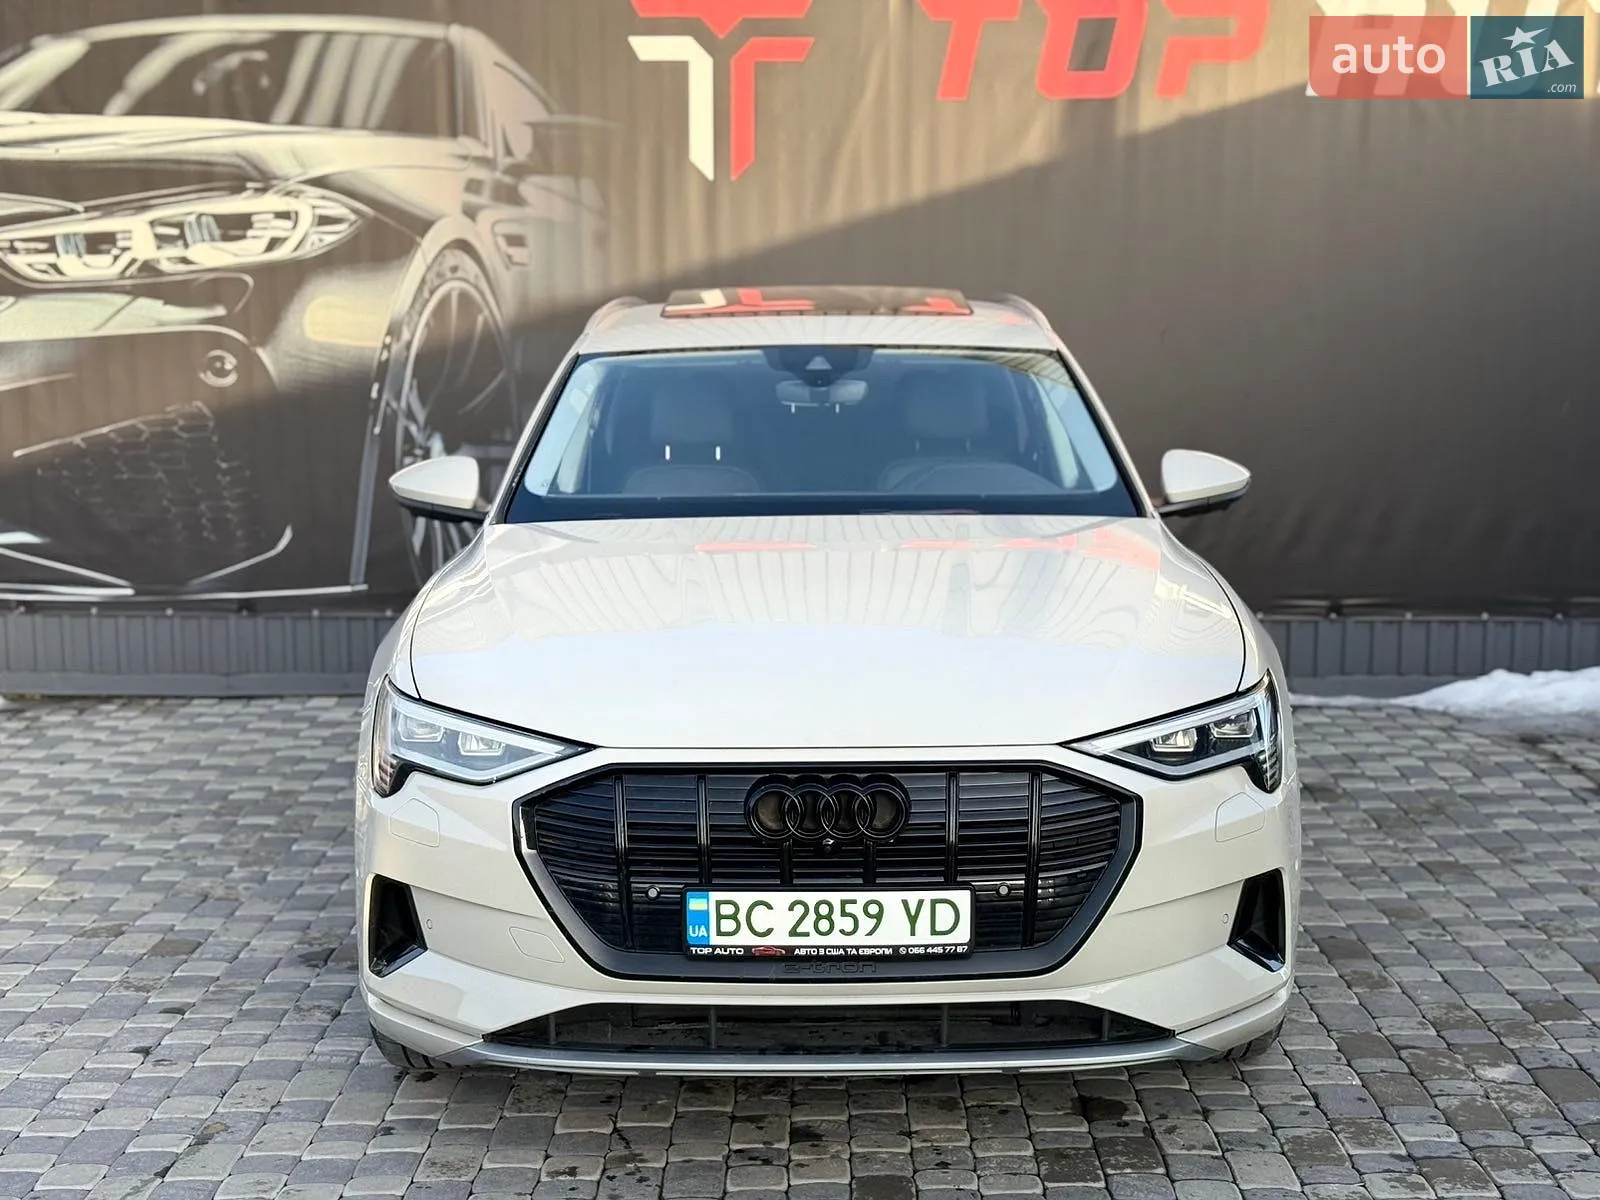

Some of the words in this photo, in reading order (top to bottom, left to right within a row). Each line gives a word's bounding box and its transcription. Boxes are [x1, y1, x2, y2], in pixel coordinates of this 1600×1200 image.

[918, 0, 1268, 100] TOP
[715, 899, 774, 937] BC
[788, 898, 884, 937] 2859
[901, 898, 960, 936] YD
[689, 925, 708, 937] UA
[690, 947, 713, 955] TOP
[714, 947, 744, 955] AUTO
